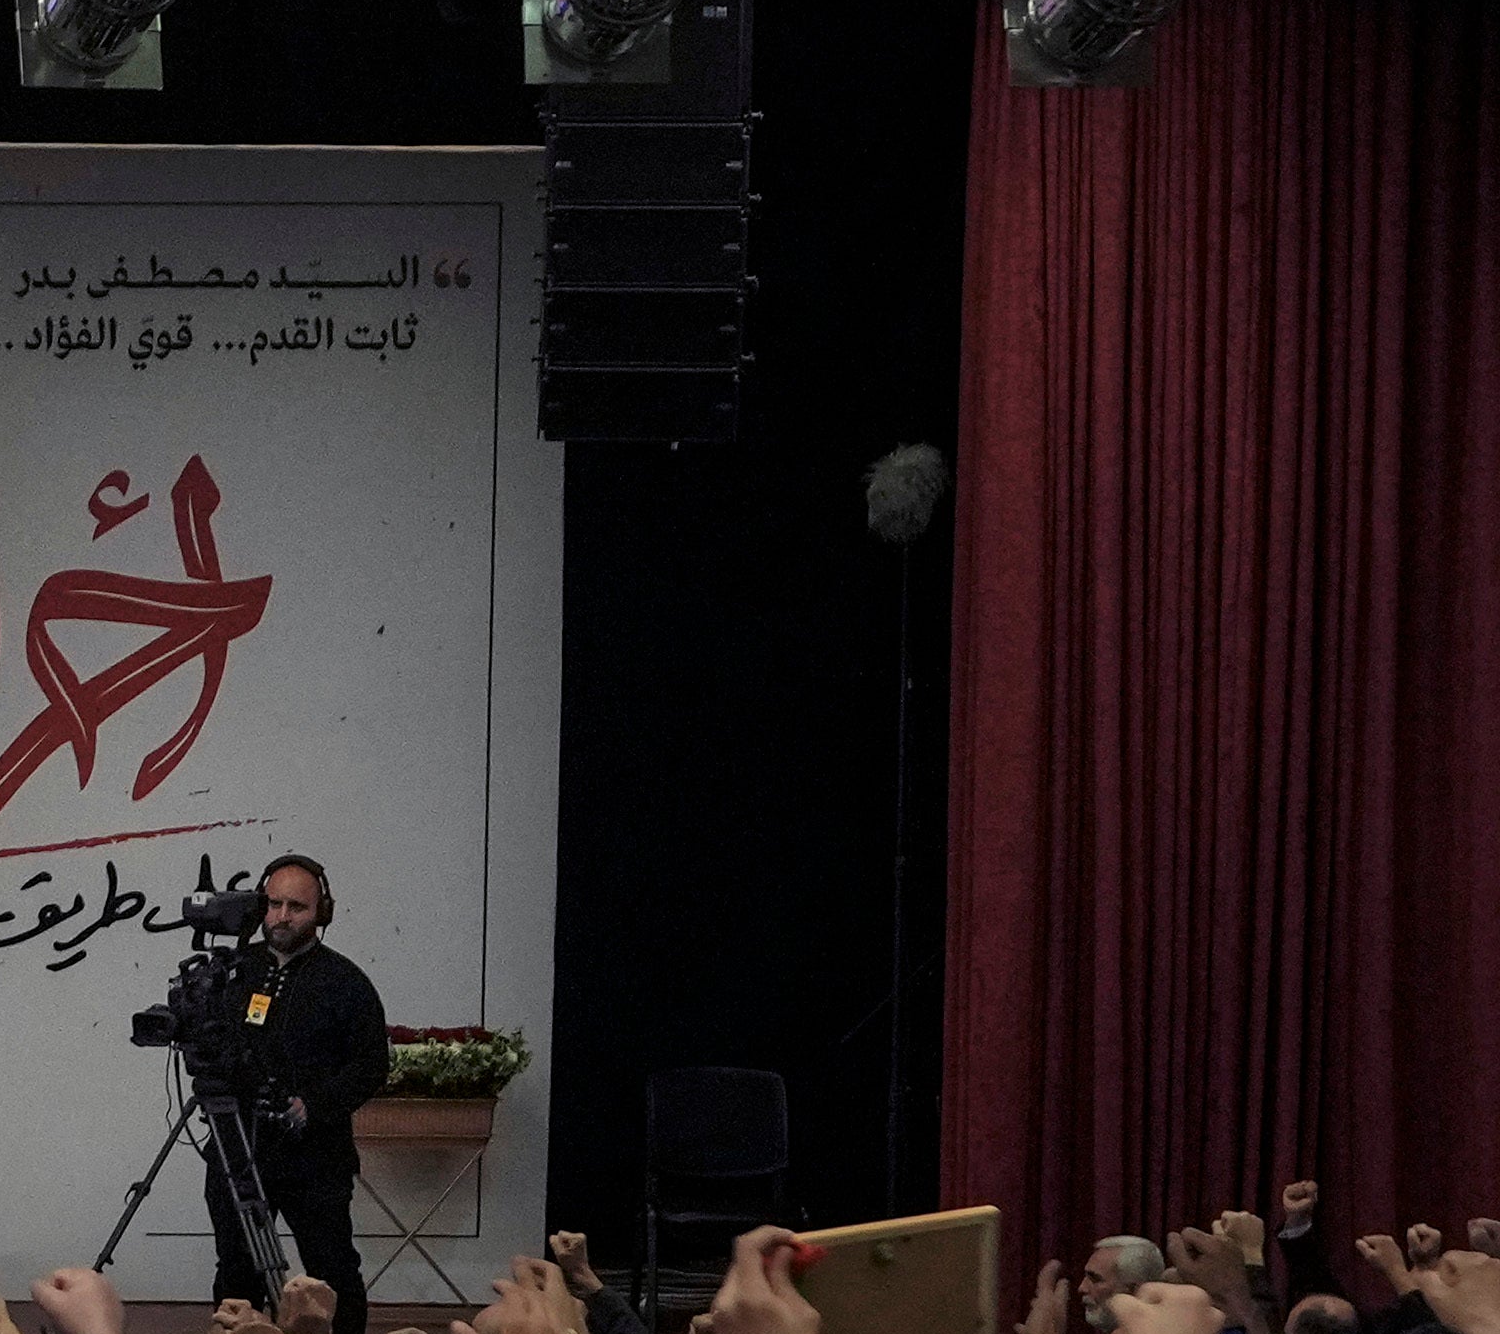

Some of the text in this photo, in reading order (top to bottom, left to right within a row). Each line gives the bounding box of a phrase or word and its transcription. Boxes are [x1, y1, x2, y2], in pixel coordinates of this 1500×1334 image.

[14, 266, 76, 300] بدر
[87, 255, 259, 298] مصطفى
[25, 315, 116, 360] الفؤاد
[346, 312, 418, 361] ثابت
